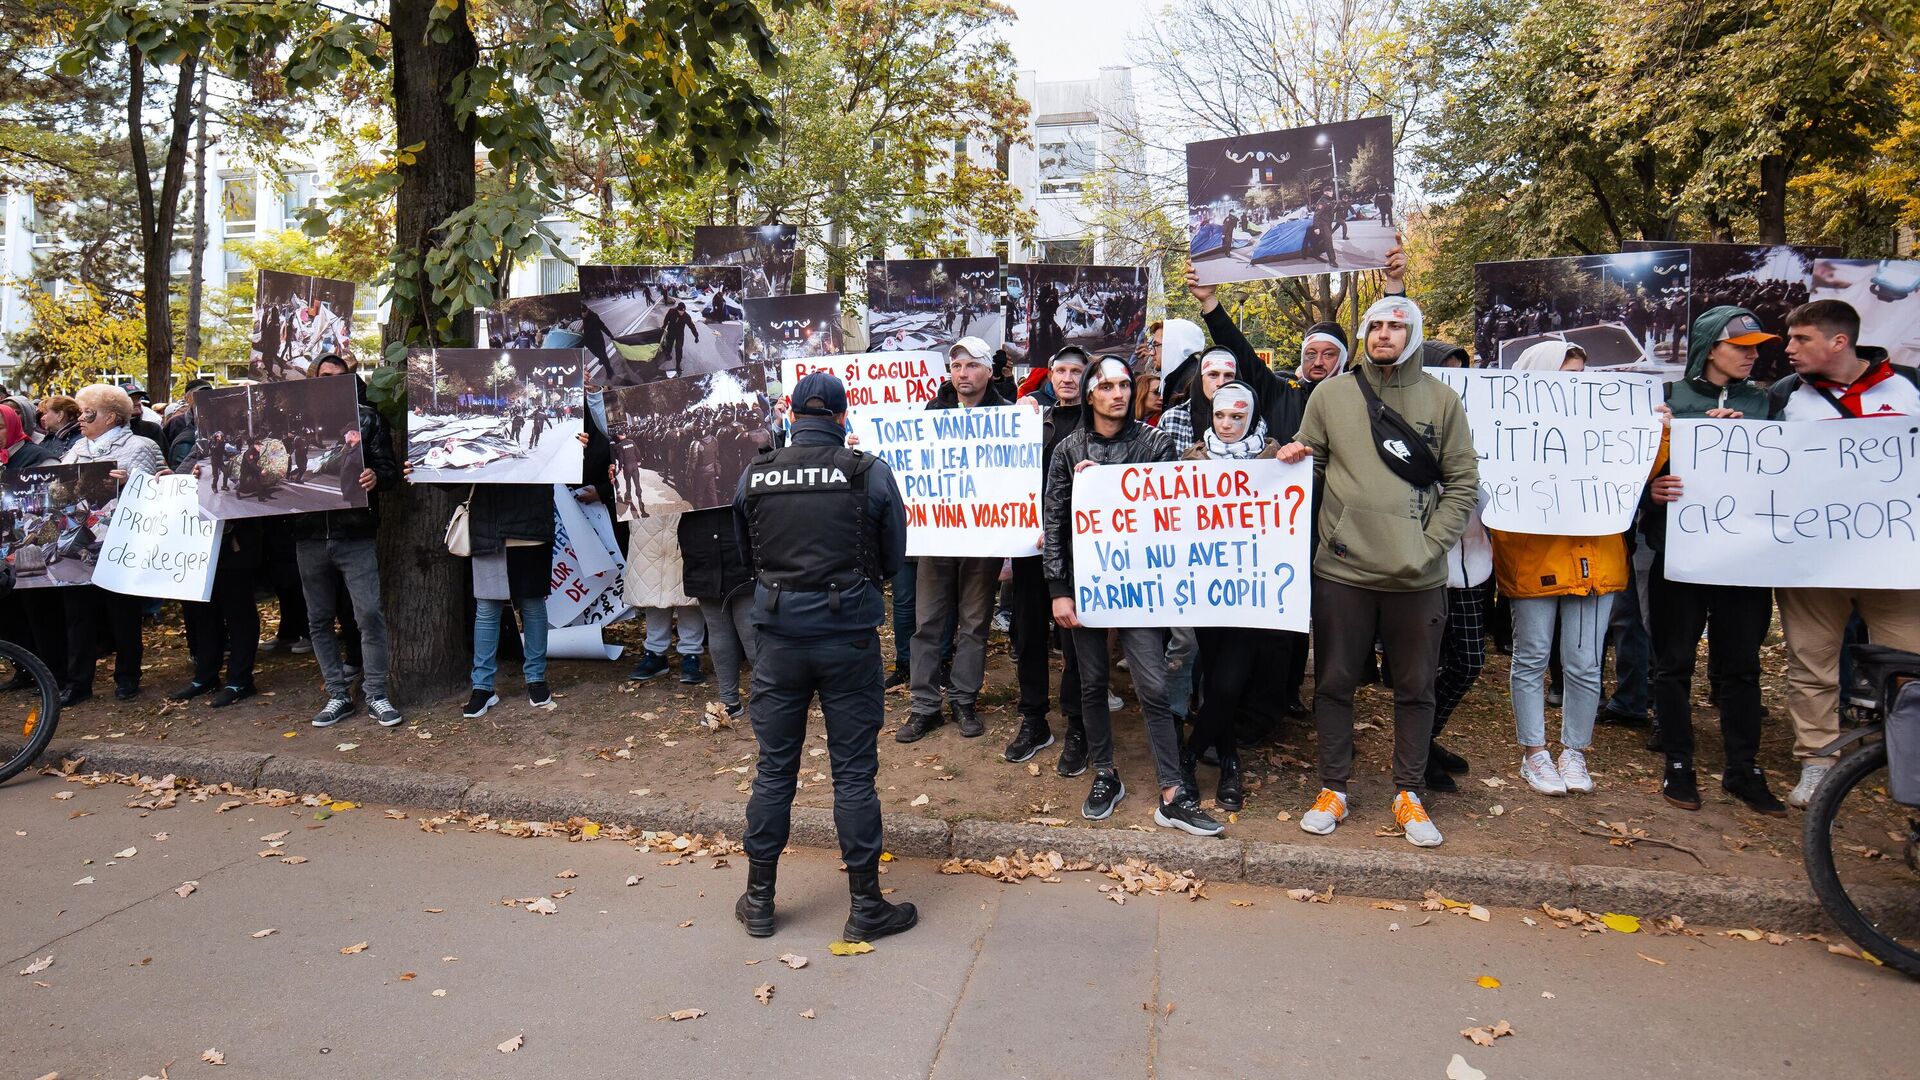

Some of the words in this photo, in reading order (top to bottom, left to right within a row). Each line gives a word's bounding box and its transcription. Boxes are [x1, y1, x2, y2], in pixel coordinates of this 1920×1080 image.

[867, 359, 929, 380] CAGULA
[884, 386, 901, 404] AL
[871, 417, 924, 445] TOATE
[933, 408, 1022, 440] VÂNĂTĂILE
[942, 446, 969, 469] LE-A
[976, 442, 1043, 468] PROVOCAT
[1583, 427, 1660, 465] PESTE
[1693, 424, 1791, 475] PAS
[750, 468, 848, 488] POLIȚIA
[1121, 465, 1259, 502] CĂLĂILOR,
[932, 498, 967, 528] VINA
[971, 492, 1040, 529] VOASTRĂ
[1075, 509, 1102, 534] DE
[1112, 508, 1138, 533] CE
[1153, 506, 1182, 532] NE
[107, 542, 137, 569] de
[1145, 543, 1176, 569] NU
[1188, 533, 1259, 573] AVEȚI
[565, 577, 590, 604] DE
[1079, 573, 1165, 613] PĂRINȚI
